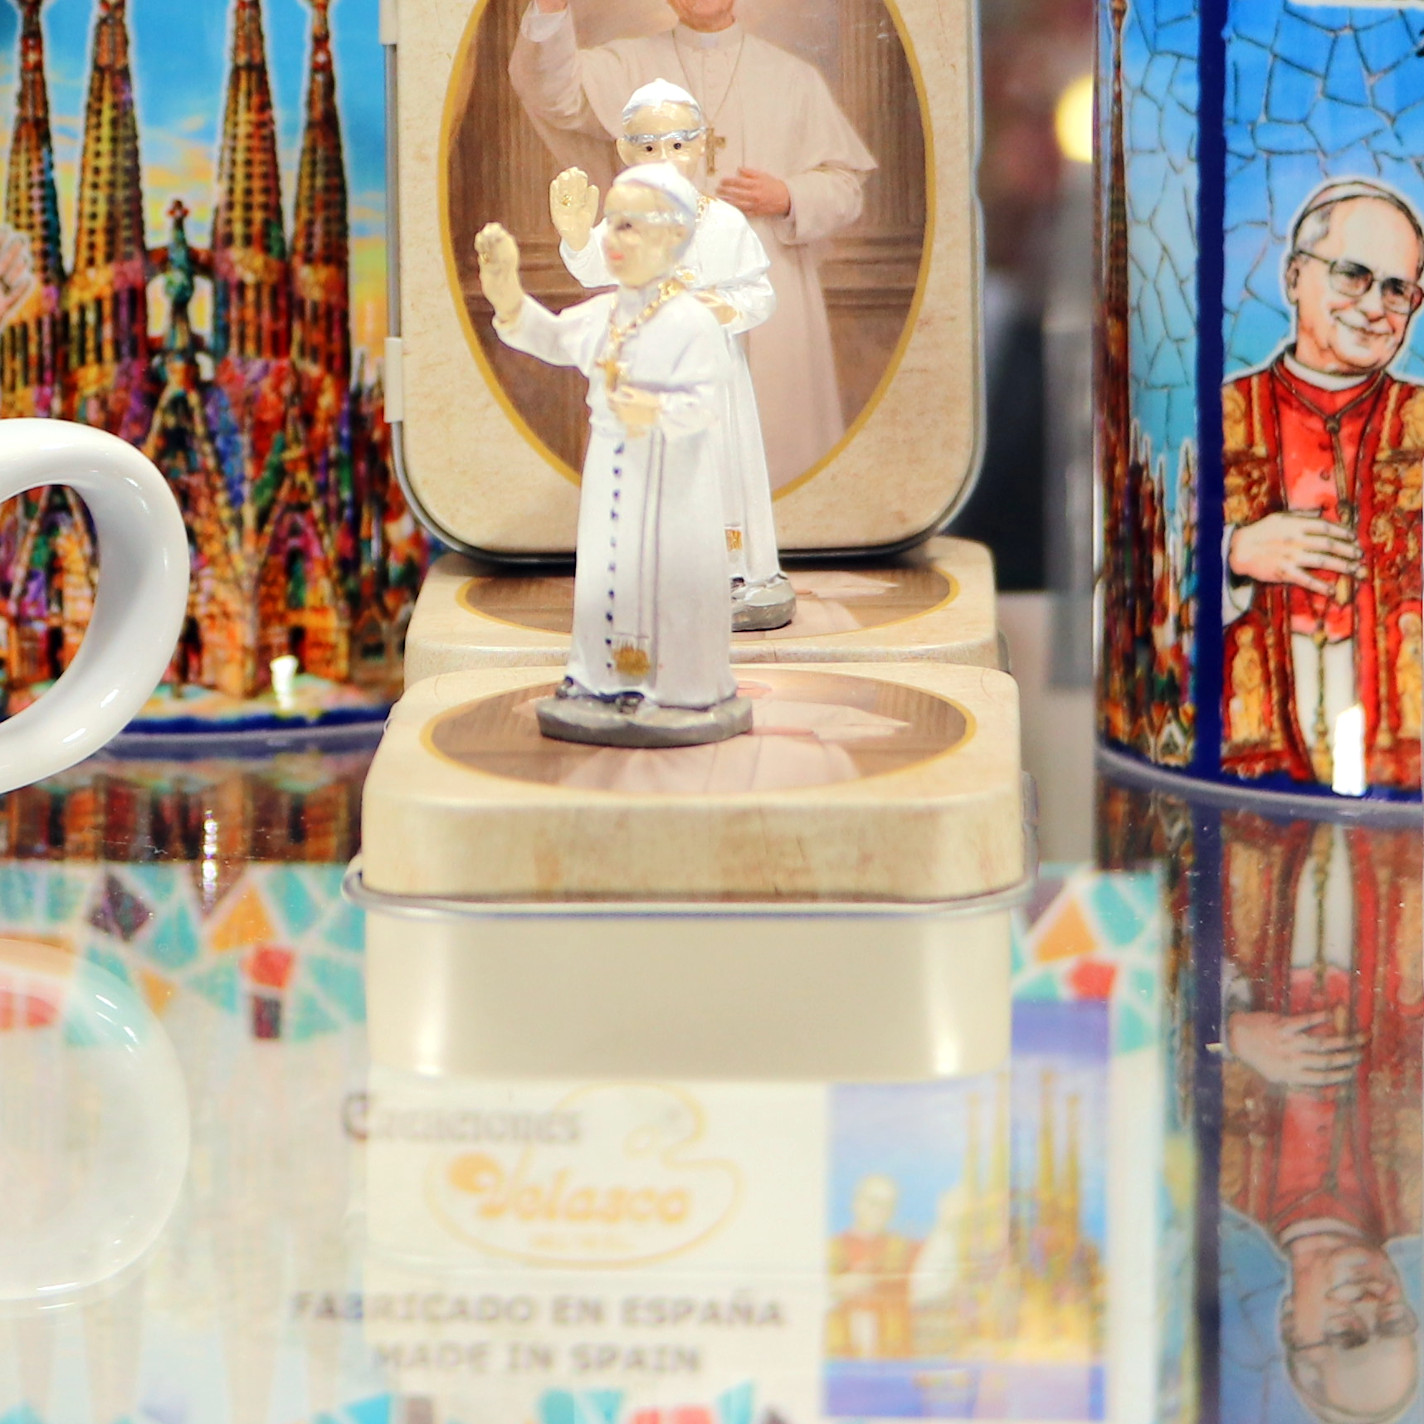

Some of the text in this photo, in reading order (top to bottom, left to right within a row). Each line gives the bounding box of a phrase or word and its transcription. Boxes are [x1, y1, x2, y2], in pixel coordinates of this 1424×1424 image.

[552, 1295, 604, 1325] EN
[621, 1287, 786, 1327] ESPAÑA
[375, 1342, 701, 1373] MADE IN SPAIN
